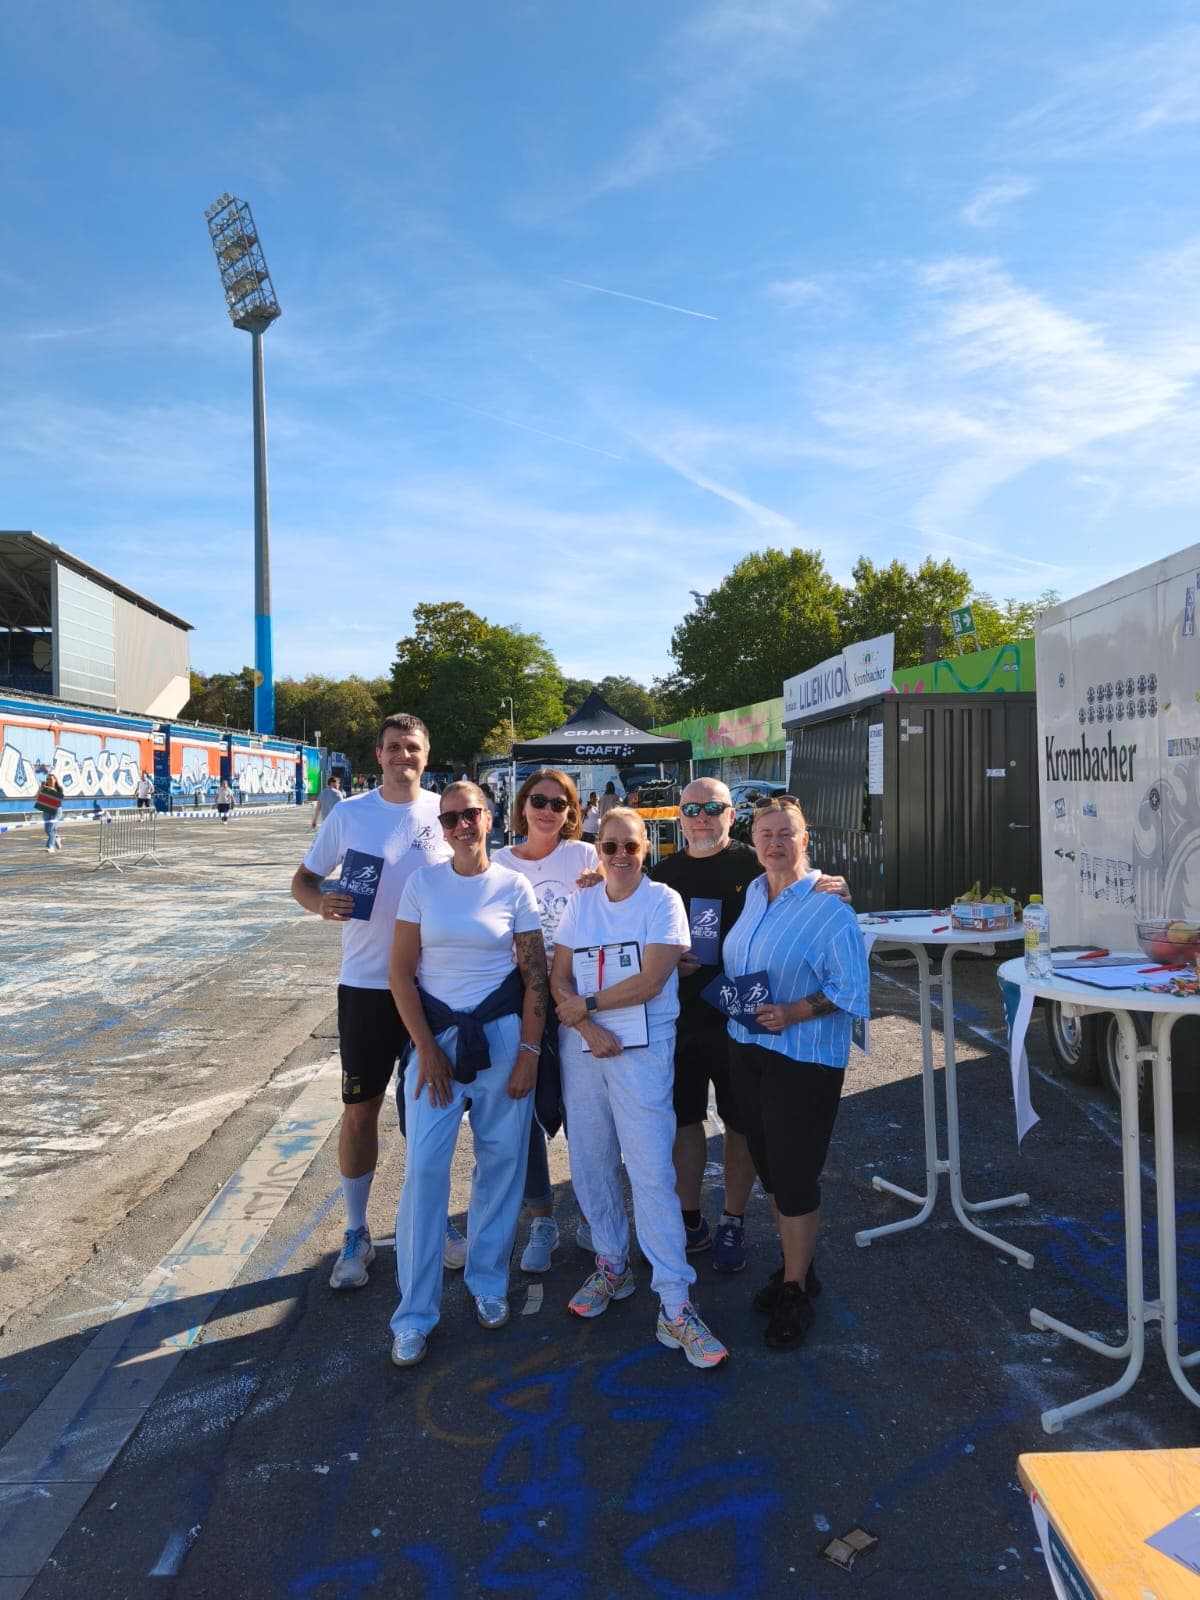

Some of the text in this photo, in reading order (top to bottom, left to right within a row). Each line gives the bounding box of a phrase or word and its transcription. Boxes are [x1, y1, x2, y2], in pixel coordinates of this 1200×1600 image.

[563, 729, 622, 737] CRAFT
[575, 745, 622, 755] CRAFT
[1045, 728, 1137, 783] Krombacher
